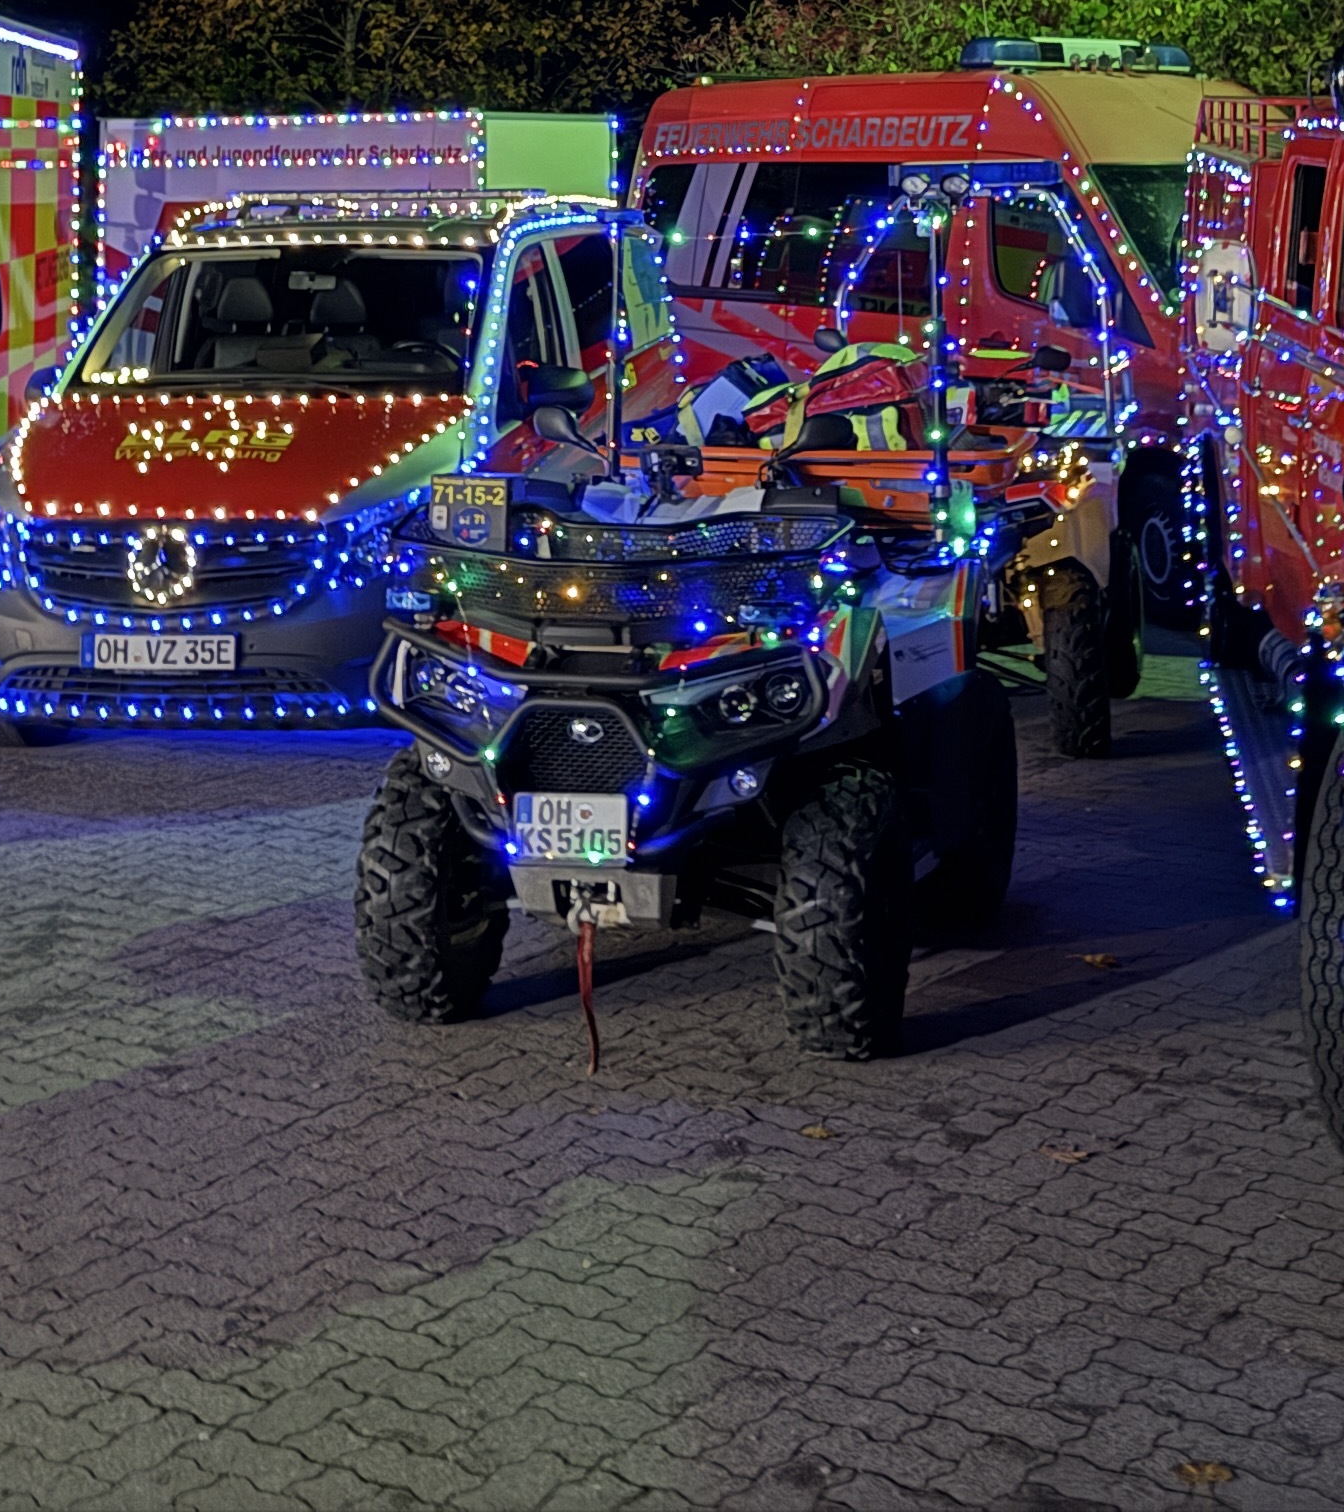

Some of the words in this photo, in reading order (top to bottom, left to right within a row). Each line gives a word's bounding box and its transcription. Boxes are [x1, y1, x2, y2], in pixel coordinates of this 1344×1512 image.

[655, 120, 790, 152] FEUERWEHR
[794, 114, 973, 149] SCHARBEUTZ
[433, 485, 505, 506] 71-15-2
[97, 638, 129, 664] OH
[145, 639, 178, 665] VZ
[184, 639, 232, 665] 35E
[537, 798, 572, 826] OH
